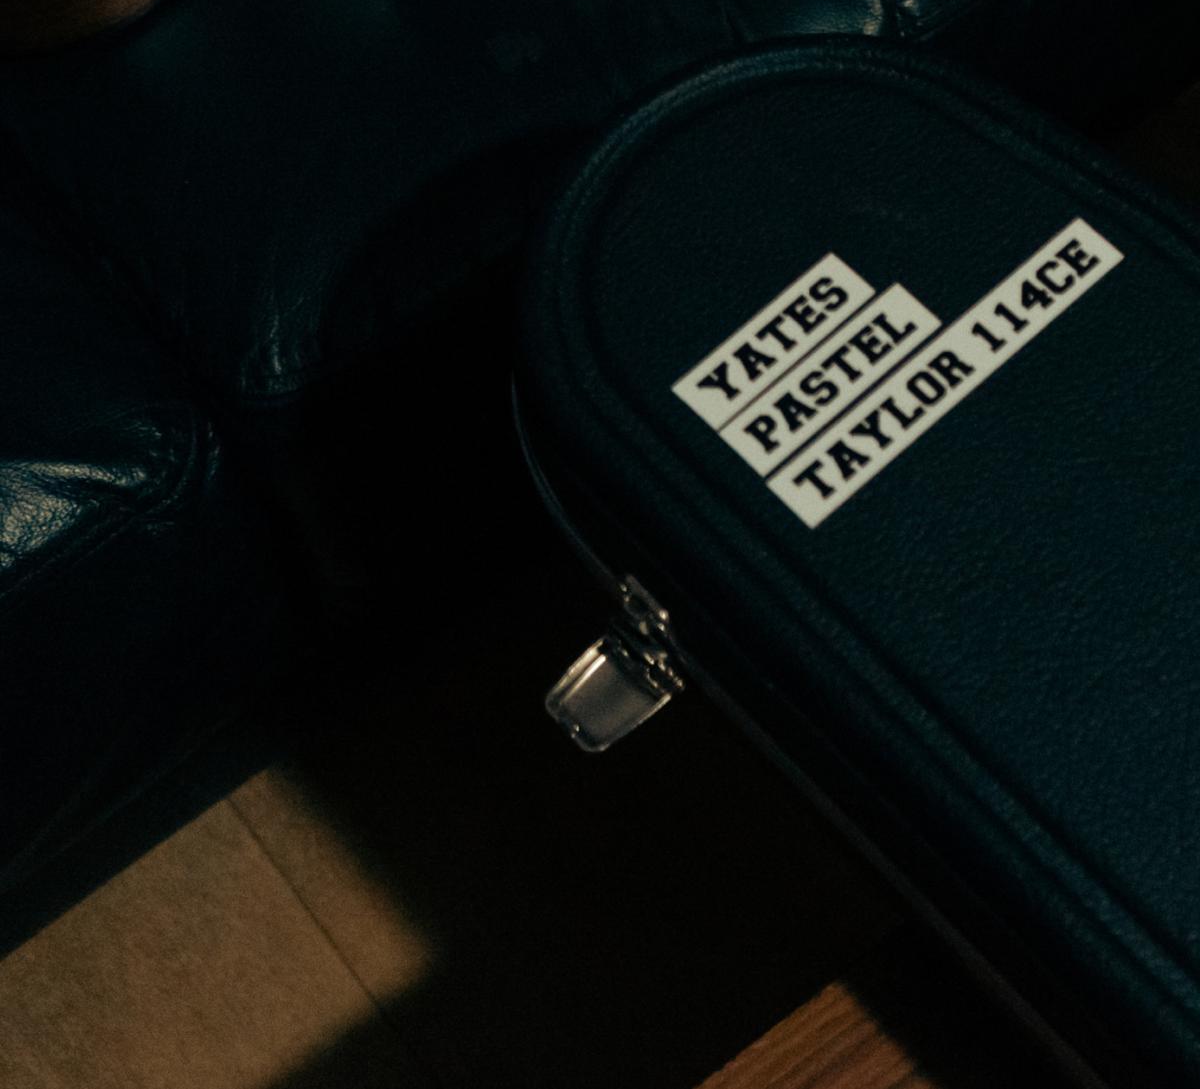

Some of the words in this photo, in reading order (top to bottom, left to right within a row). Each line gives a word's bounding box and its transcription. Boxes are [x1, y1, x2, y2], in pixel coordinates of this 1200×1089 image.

[697, 276, 848, 402] YATES
[743, 313, 917, 453] PASTEL
[793, 350, 974, 500] TAYLOR
[971, 239, 1100, 353] 114CE
